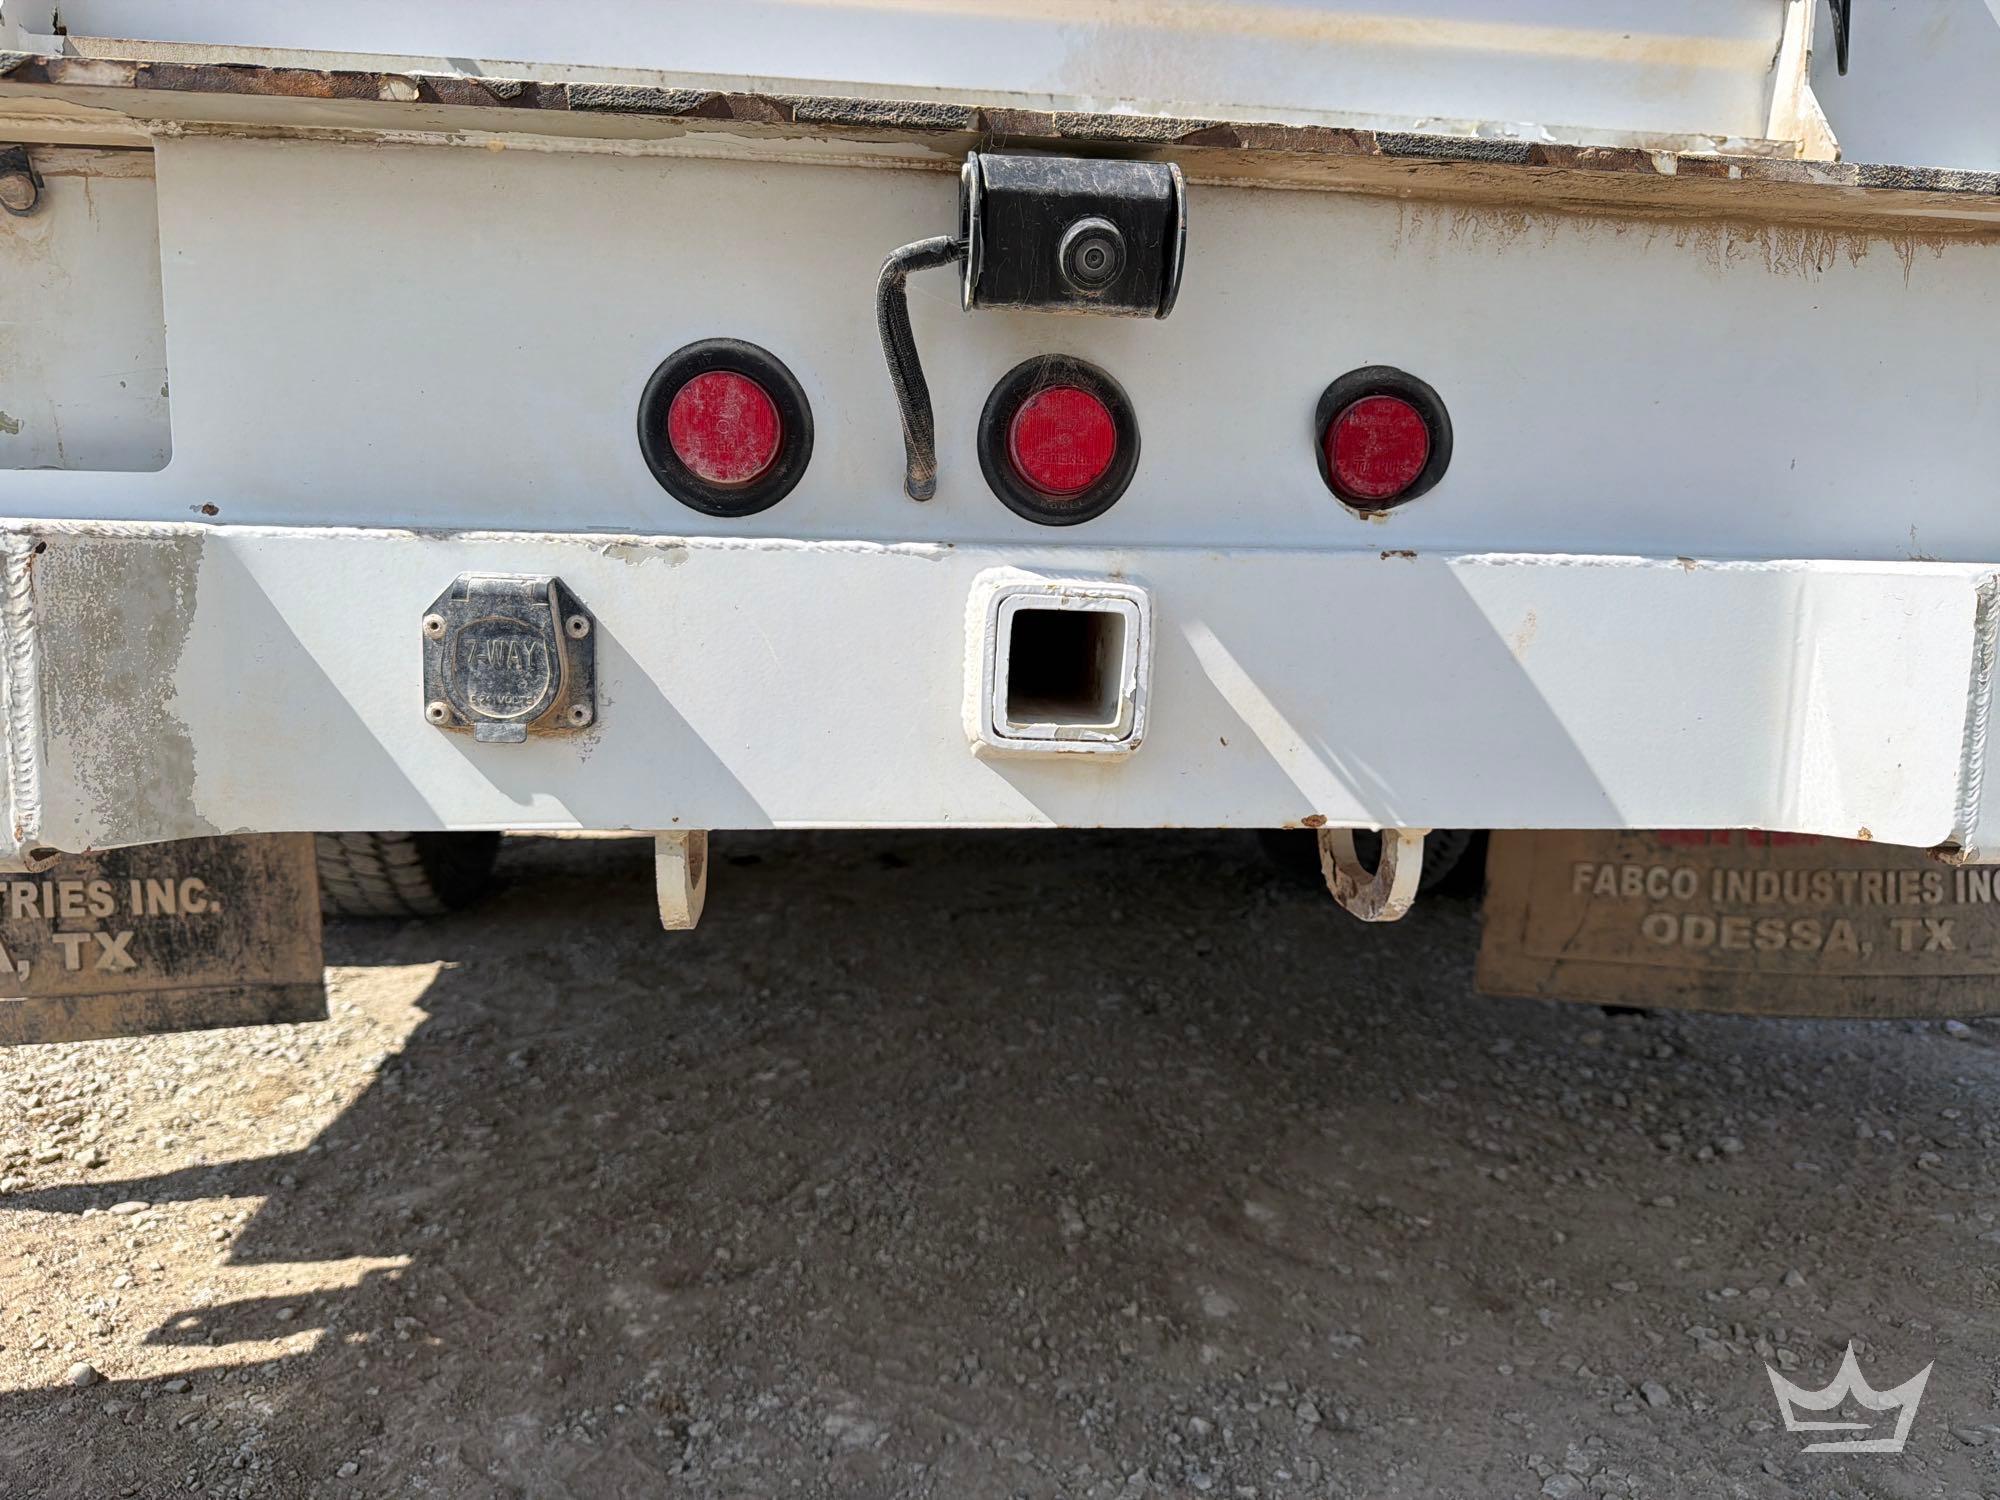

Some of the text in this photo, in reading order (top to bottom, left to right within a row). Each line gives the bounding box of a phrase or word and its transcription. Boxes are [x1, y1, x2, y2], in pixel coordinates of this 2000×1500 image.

[463, 638, 537, 671] 7-WAY
[0, 876, 221, 919] RIES INC.
[1572, 862, 2000, 905] FABCO INDUSTRIES IN
[52, 930, 138, 972] TX
[1641, 911, 1958, 957] ODESSA, TX
